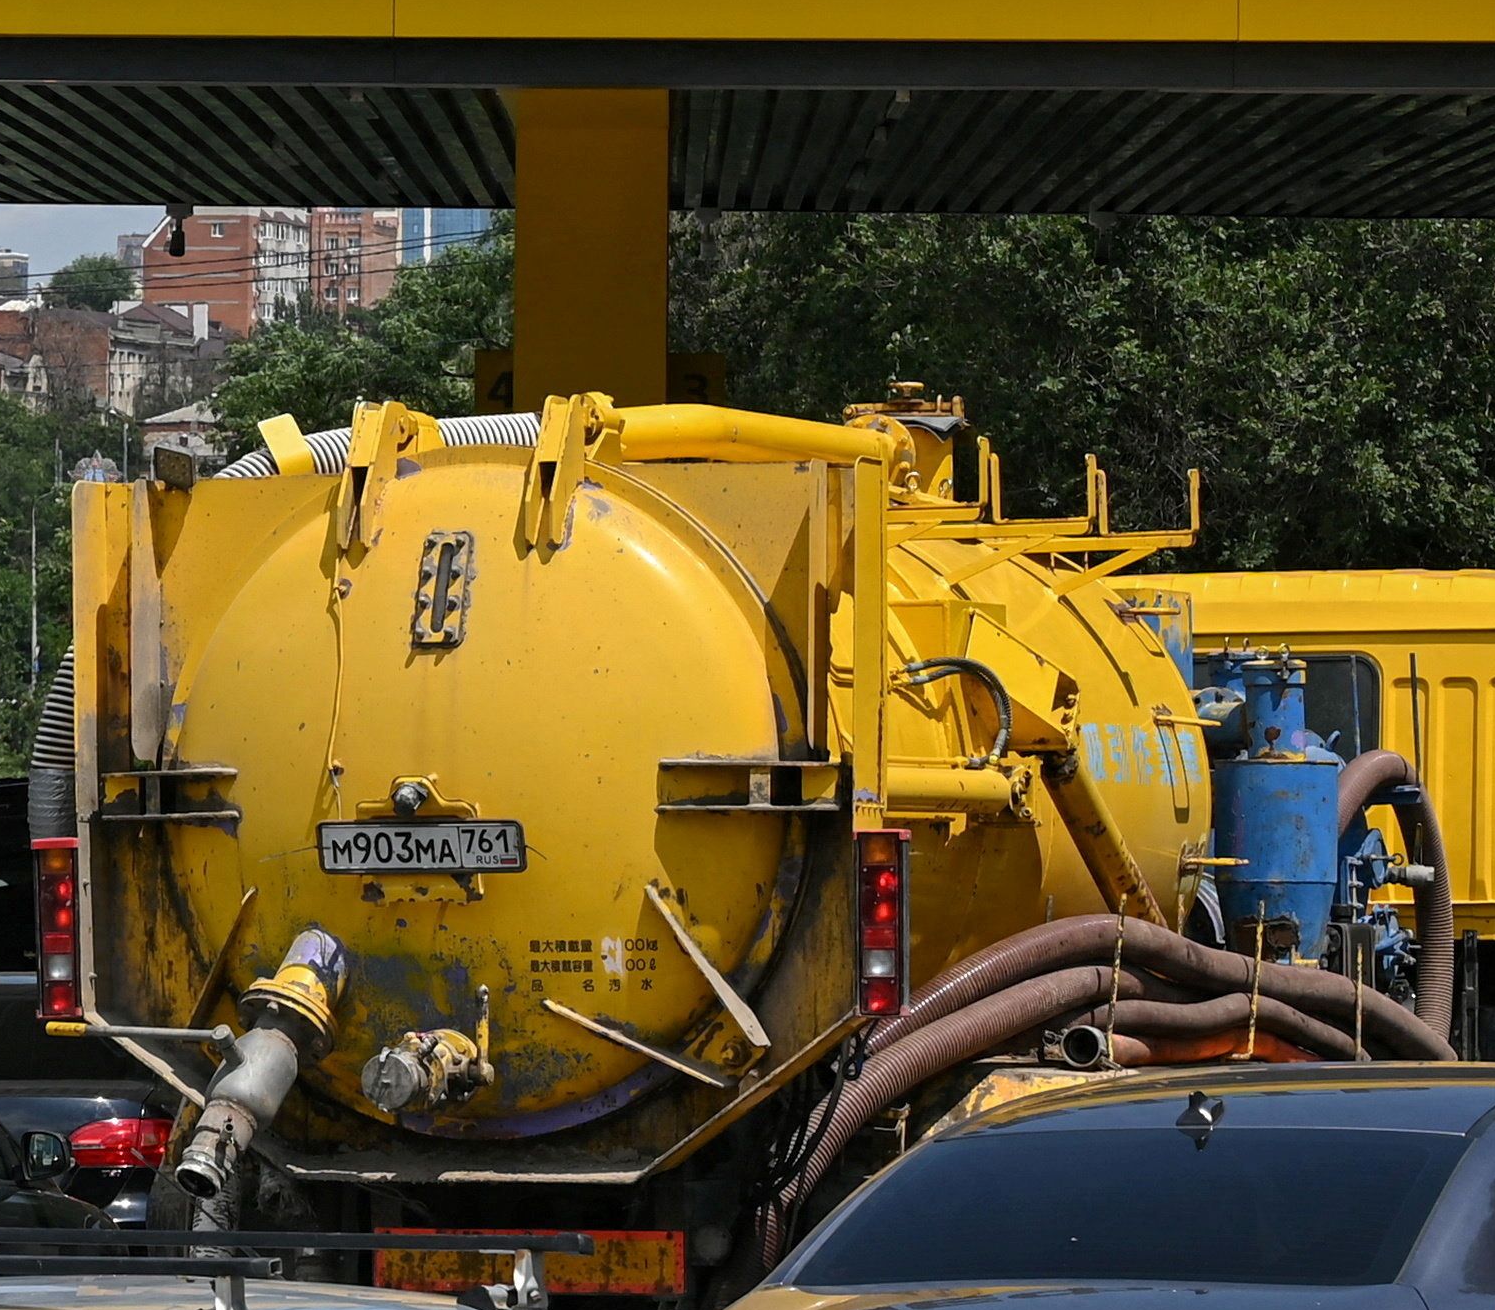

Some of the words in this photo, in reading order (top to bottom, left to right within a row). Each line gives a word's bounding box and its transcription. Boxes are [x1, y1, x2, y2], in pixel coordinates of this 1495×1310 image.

[486, 370, 514, 409] 4
[331, 831, 456, 864] М903МА
[461, 828, 510, 854] 761
[476, 853, 499, 865] RUS
